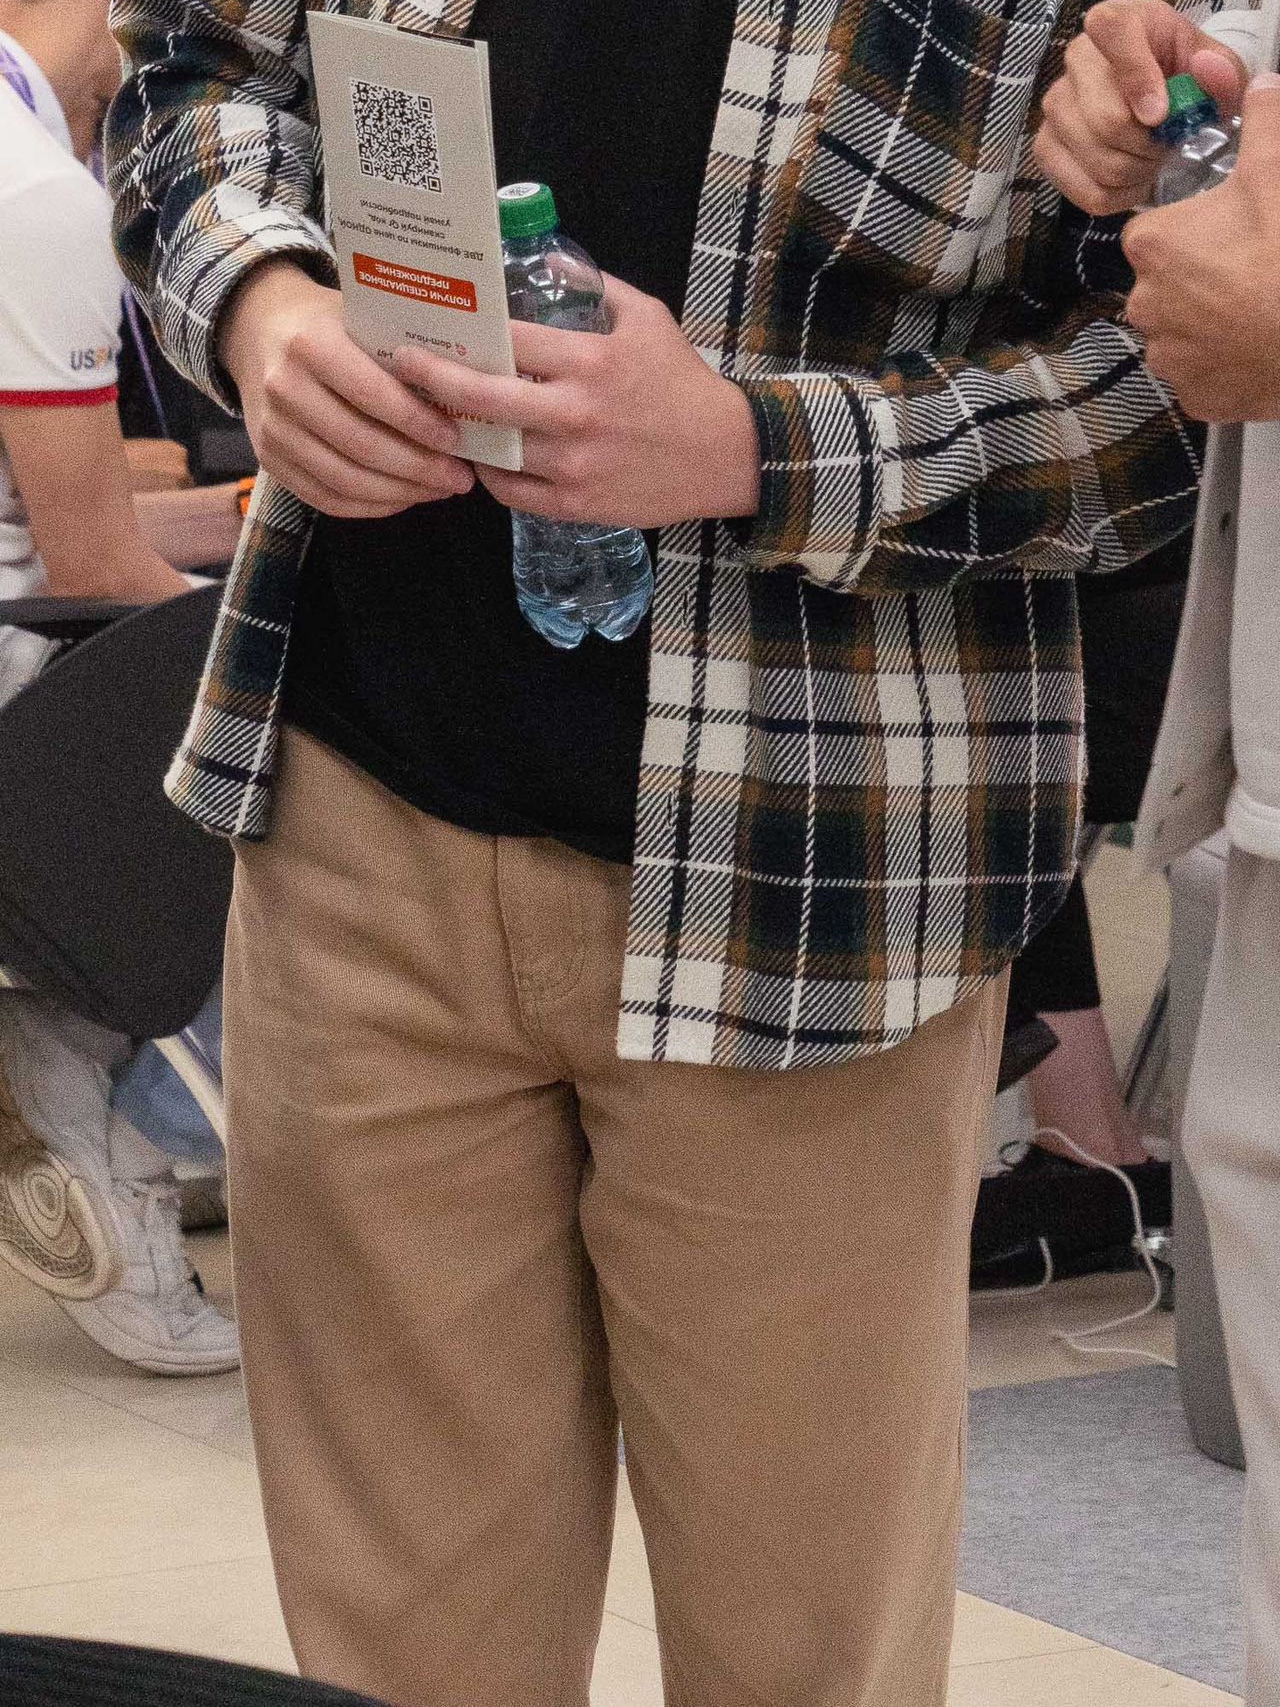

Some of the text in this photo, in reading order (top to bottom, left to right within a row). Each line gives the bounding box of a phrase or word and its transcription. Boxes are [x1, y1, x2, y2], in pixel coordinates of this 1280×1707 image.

[424, 213, 451, 227] узнай
[374, 228, 397, 241] цене
[401, 223, 445, 239] сканируй
[398, 234, 409, 243] по
[410, 237, 461, 257] франшизы
[464, 249, 484, 261] ДВЕ
[359, 271, 471, 307] ПОЛУЧИ СПЕЦИАЛЬНОЕ
